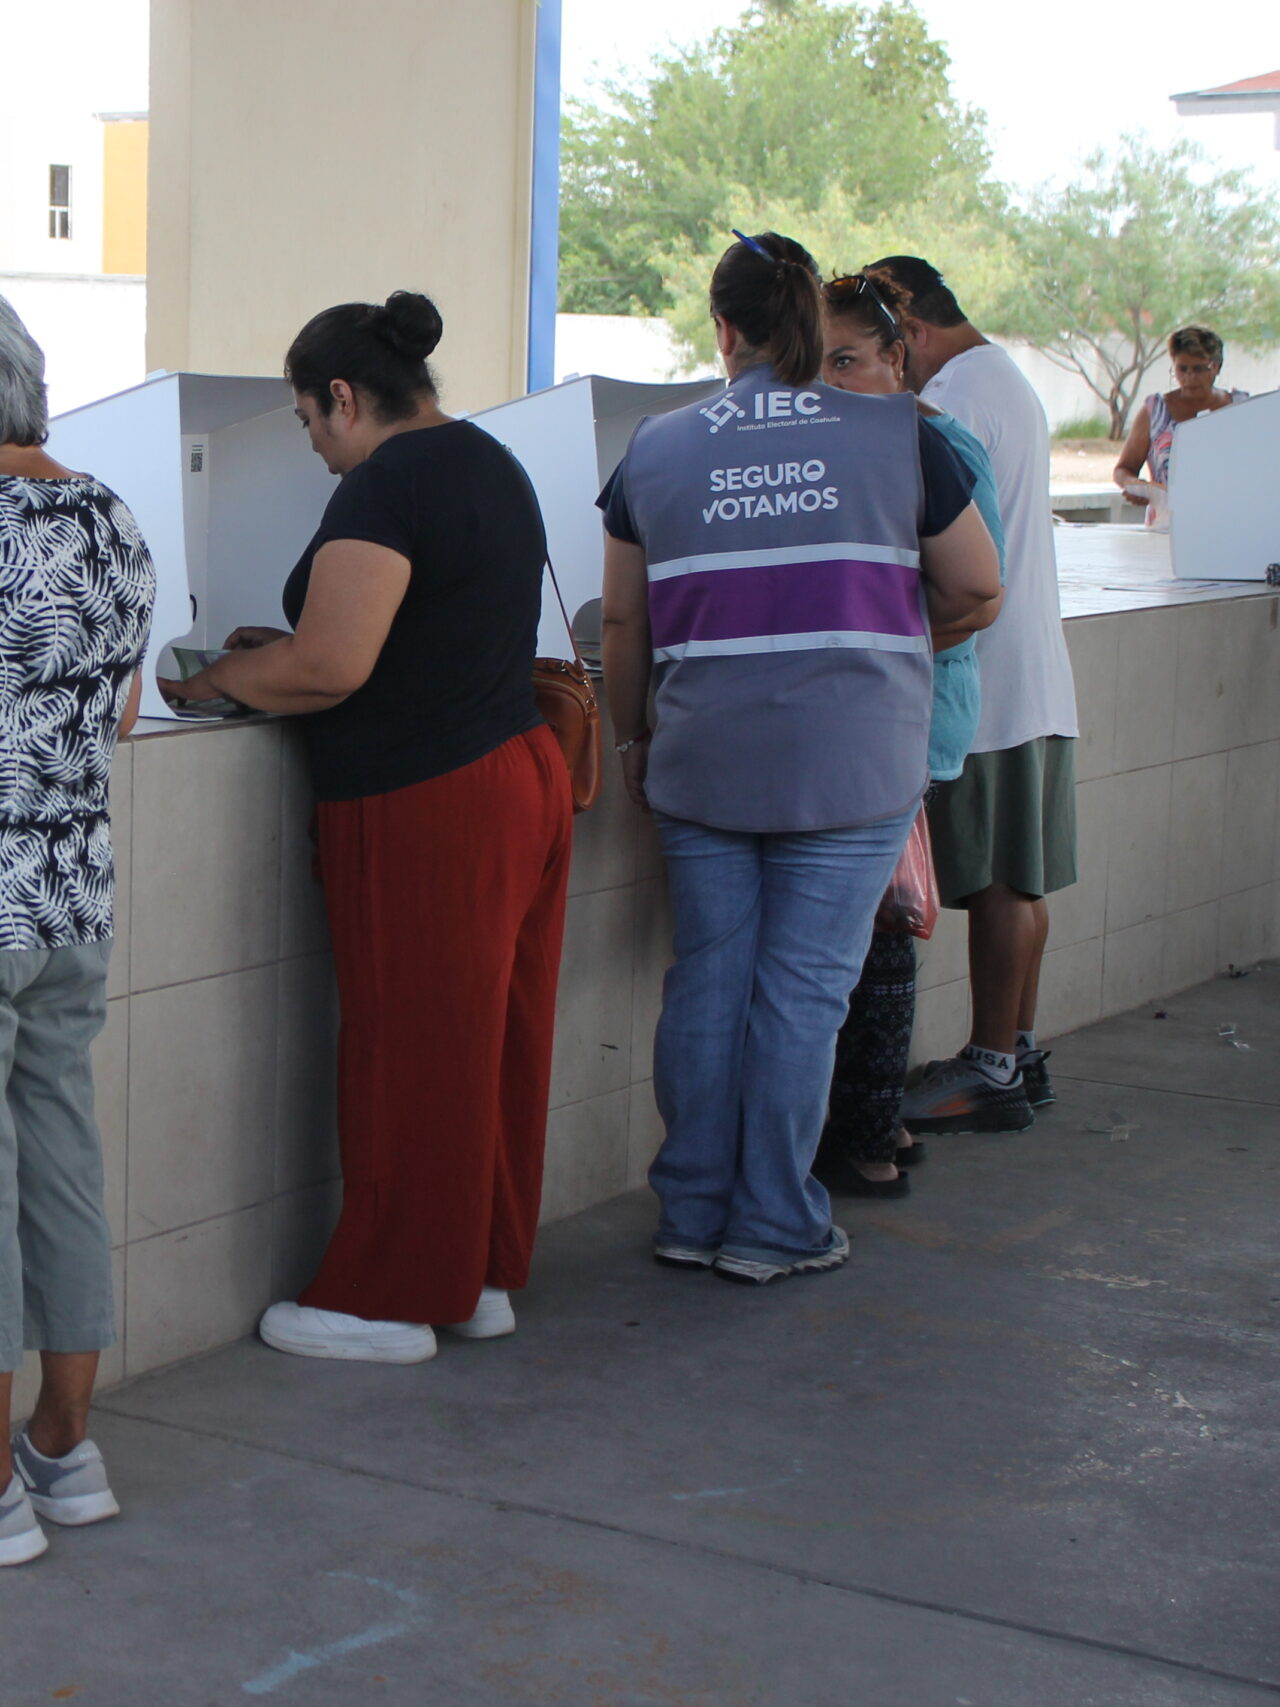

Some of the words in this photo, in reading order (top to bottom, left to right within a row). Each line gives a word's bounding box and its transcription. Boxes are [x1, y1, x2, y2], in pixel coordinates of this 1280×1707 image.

[754, 391, 822, 420] IEC
[767, 419, 798, 429] Electoral
[809, 416, 841, 424] Coahuila
[709, 459, 826, 492] SEGURO
[702, 486, 839, 524] VOTAMOS
